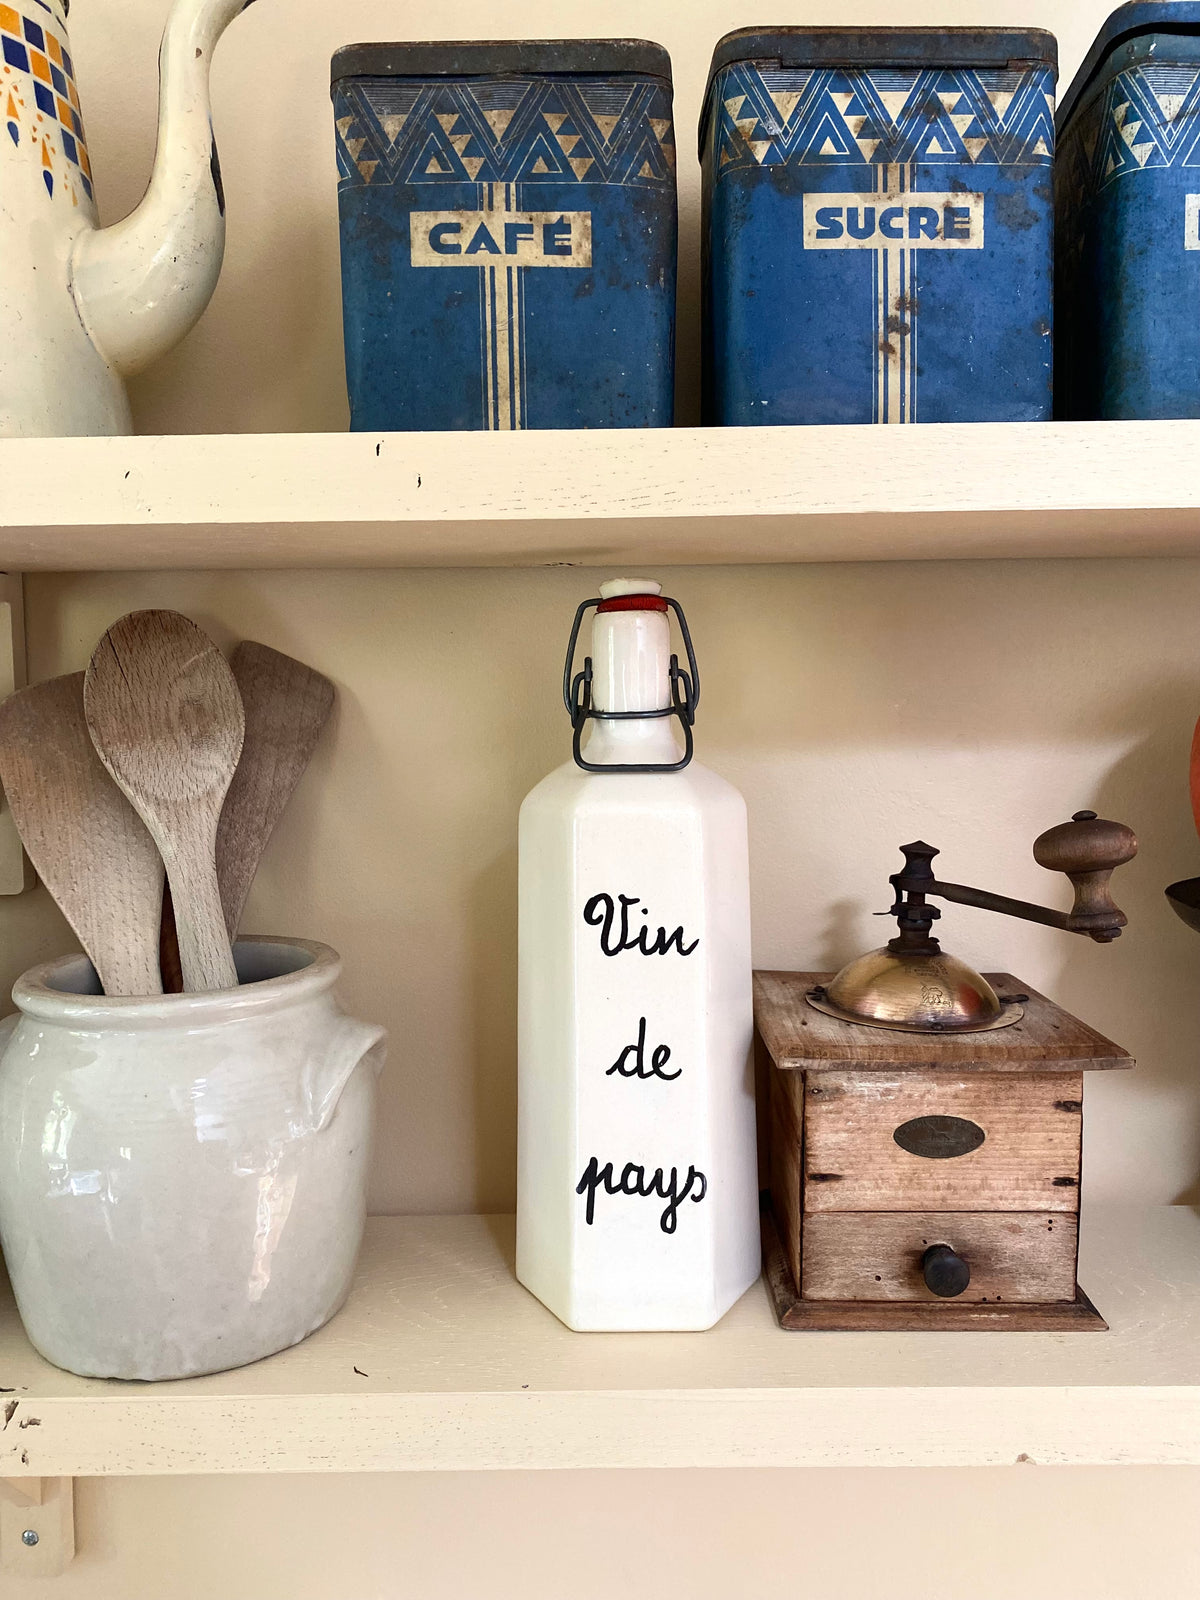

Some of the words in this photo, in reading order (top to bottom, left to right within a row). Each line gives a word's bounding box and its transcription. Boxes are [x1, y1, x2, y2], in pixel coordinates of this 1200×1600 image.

[428, 214, 573, 256] CAFÉ
[815, 206, 971, 241] SUCRE
[583, 892, 700, 957] Vin
[605, 1016, 683, 1081] de
[575, 1156, 707, 1235] pays
